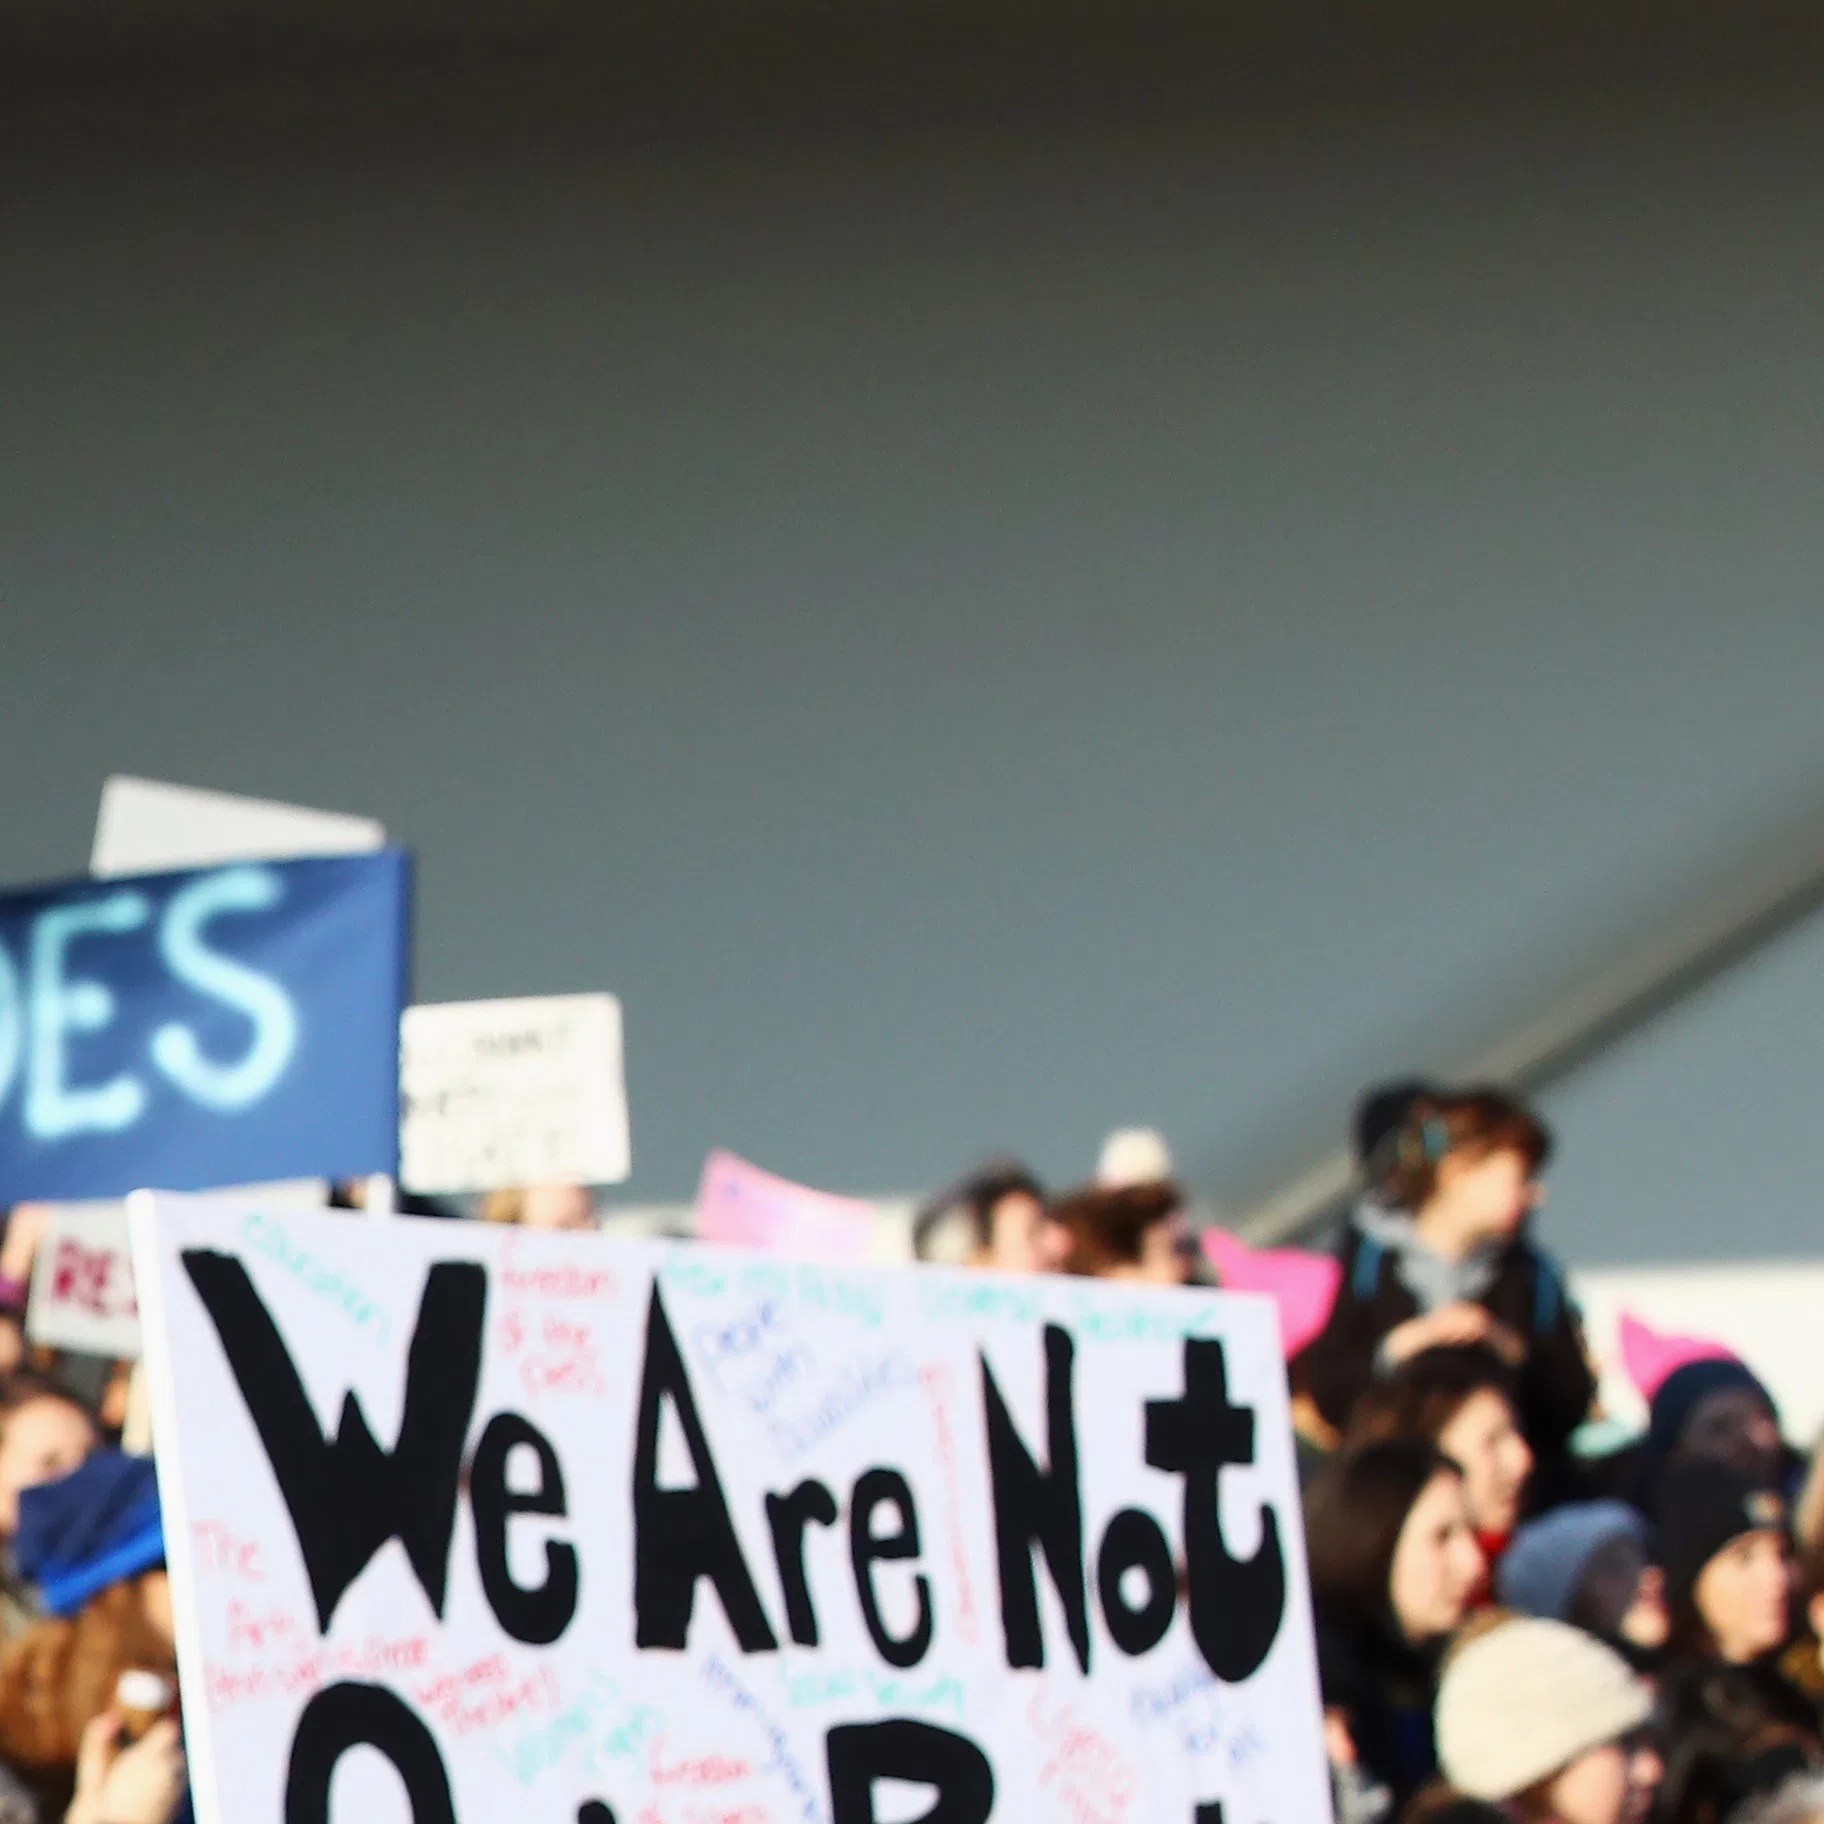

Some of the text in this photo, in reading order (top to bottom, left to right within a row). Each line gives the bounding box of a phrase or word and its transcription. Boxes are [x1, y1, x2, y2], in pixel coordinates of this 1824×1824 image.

[180, 1246, 581, 1647] We
[631, 1270, 935, 1669] Are
[977, 1320, 1287, 1683] Not
